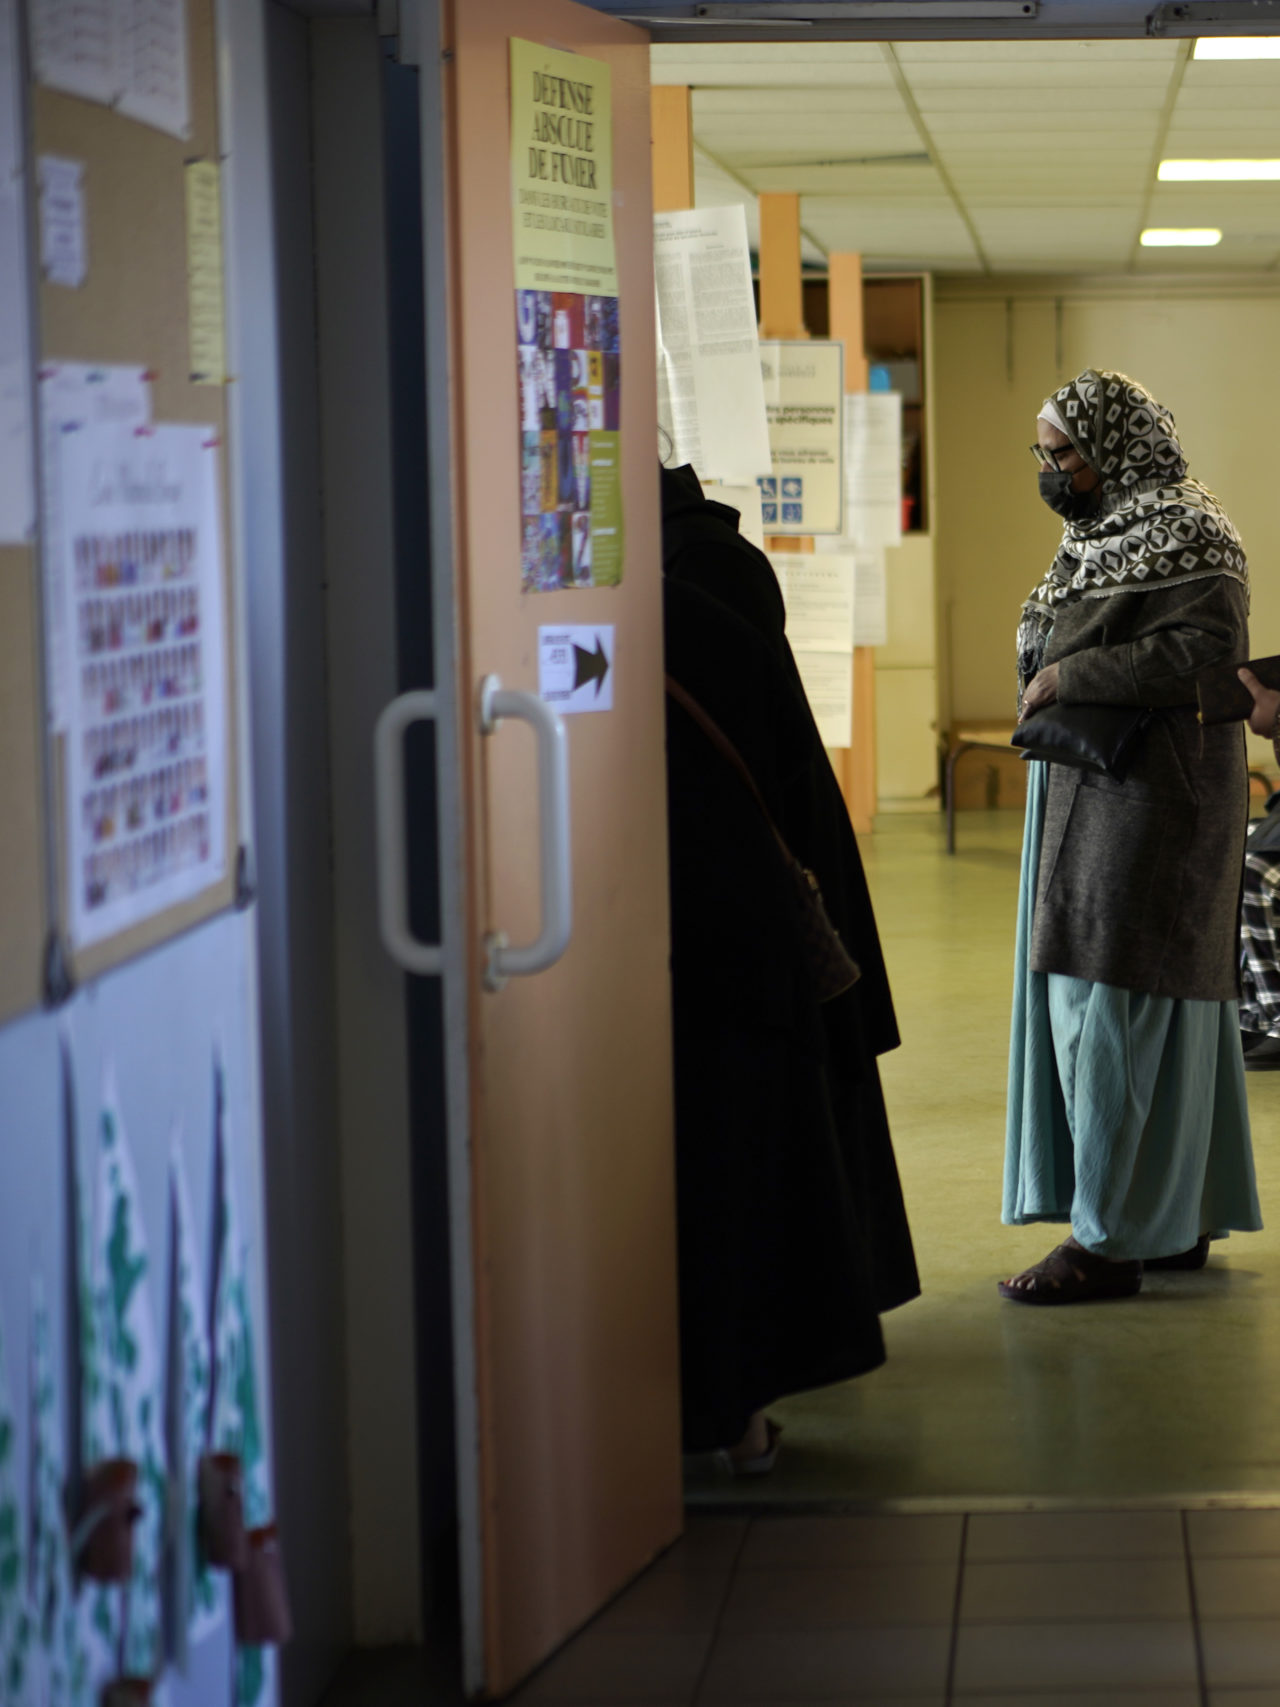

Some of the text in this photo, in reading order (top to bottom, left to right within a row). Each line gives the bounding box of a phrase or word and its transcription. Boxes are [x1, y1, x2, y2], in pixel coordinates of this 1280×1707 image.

[532, 111, 593, 153] ABSOLUE
[528, 146, 597, 190] DE FUMER
